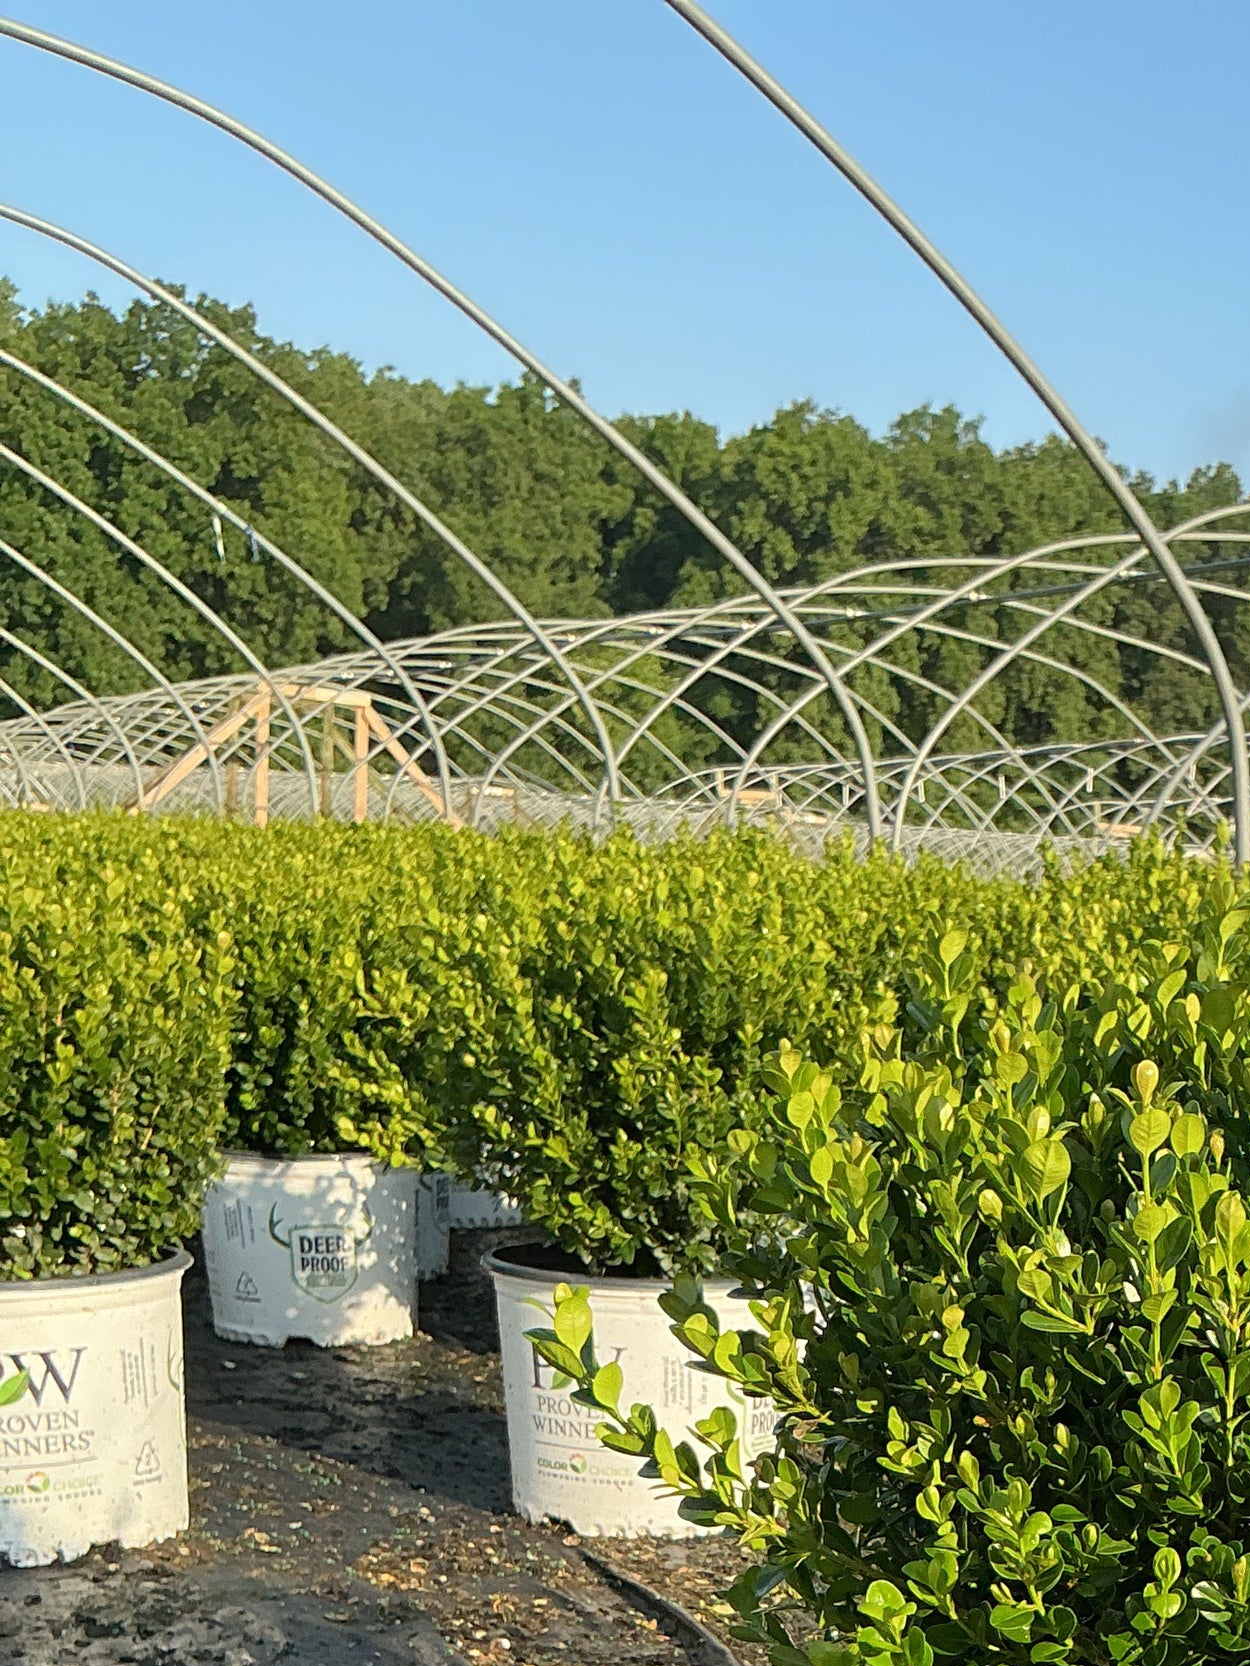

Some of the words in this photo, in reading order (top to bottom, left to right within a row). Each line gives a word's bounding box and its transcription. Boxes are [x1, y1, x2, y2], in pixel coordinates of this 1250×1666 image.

[299, 1235, 352, 1254] DEER
[301, 1256, 348, 1272] PROOF
[0, 1346, 88, 1406] W
[0, 1409, 79, 1435] OVEN
[532, 1415, 597, 1440] WINNE
[0, 1430, 94, 1457] NNERS
[537, 1457, 568, 1470] COLOR
